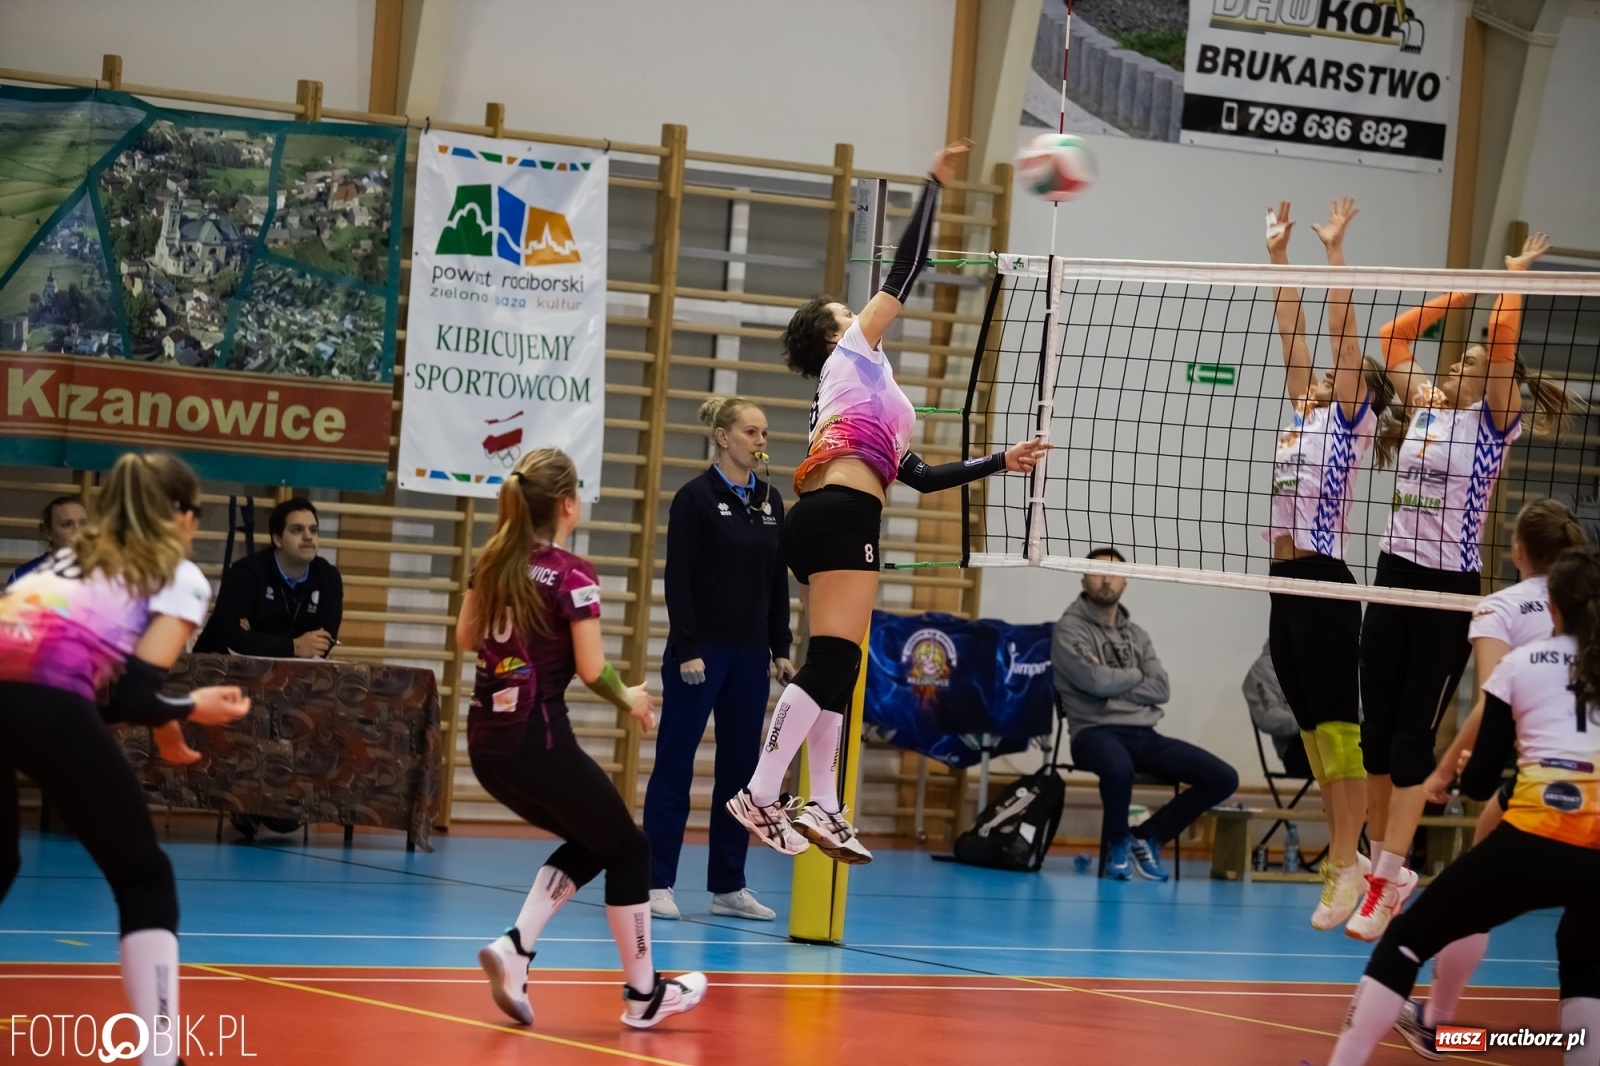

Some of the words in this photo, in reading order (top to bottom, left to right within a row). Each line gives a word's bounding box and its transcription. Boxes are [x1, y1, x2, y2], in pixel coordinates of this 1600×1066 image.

[1196, 44, 1441, 102] BRUKARSTWO
[1247, 107, 1297, 135] 798
[1303, 113, 1352, 142] 636
[1359, 120, 1408, 149] 882
[501, 272, 584, 293] raciborski
[536, 295, 583, 311] kultur
[436, 324, 575, 365] KIBICUJEMY
[414, 363, 591, 403] SPORTOWCOM
[7, 368, 347, 443] Krzanowice
[864, 543, 874, 563] 8
[1519, 601, 1544, 615] UKS
[1530, 651, 1559, 664] UKS
